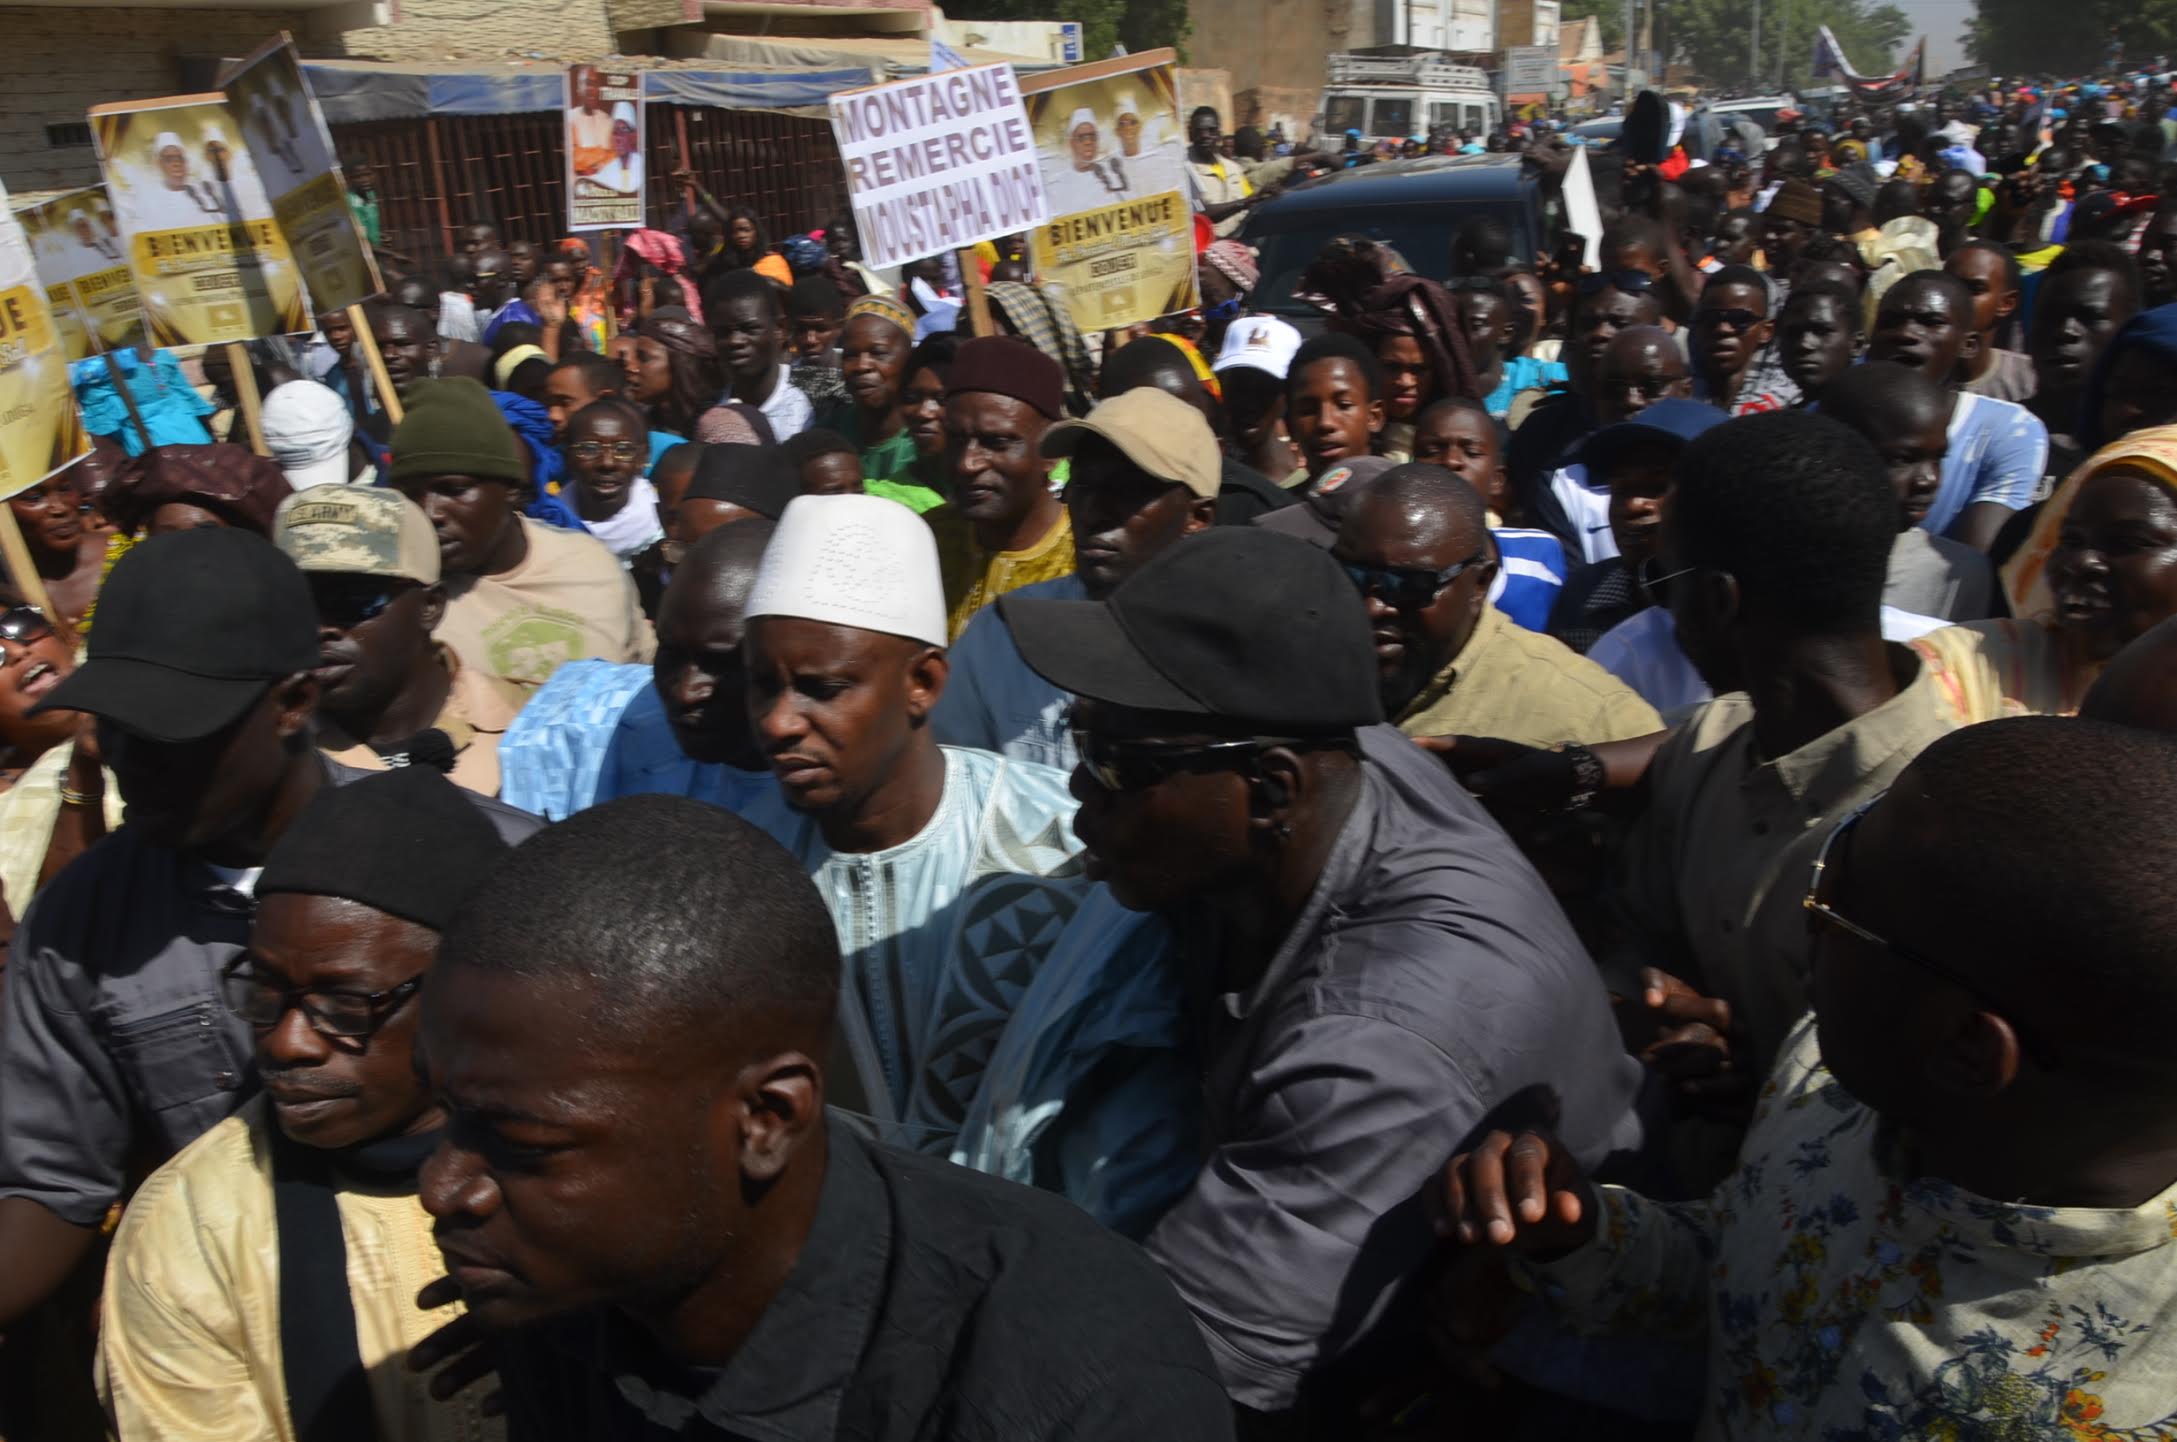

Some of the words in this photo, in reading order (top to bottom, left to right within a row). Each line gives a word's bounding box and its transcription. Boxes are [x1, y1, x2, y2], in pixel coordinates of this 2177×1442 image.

[837, 66, 1015, 144] MONTAGNE
[847, 118, 1027, 193] REMERCIE
[1050, 198, 1173, 247] BIENVENUE
